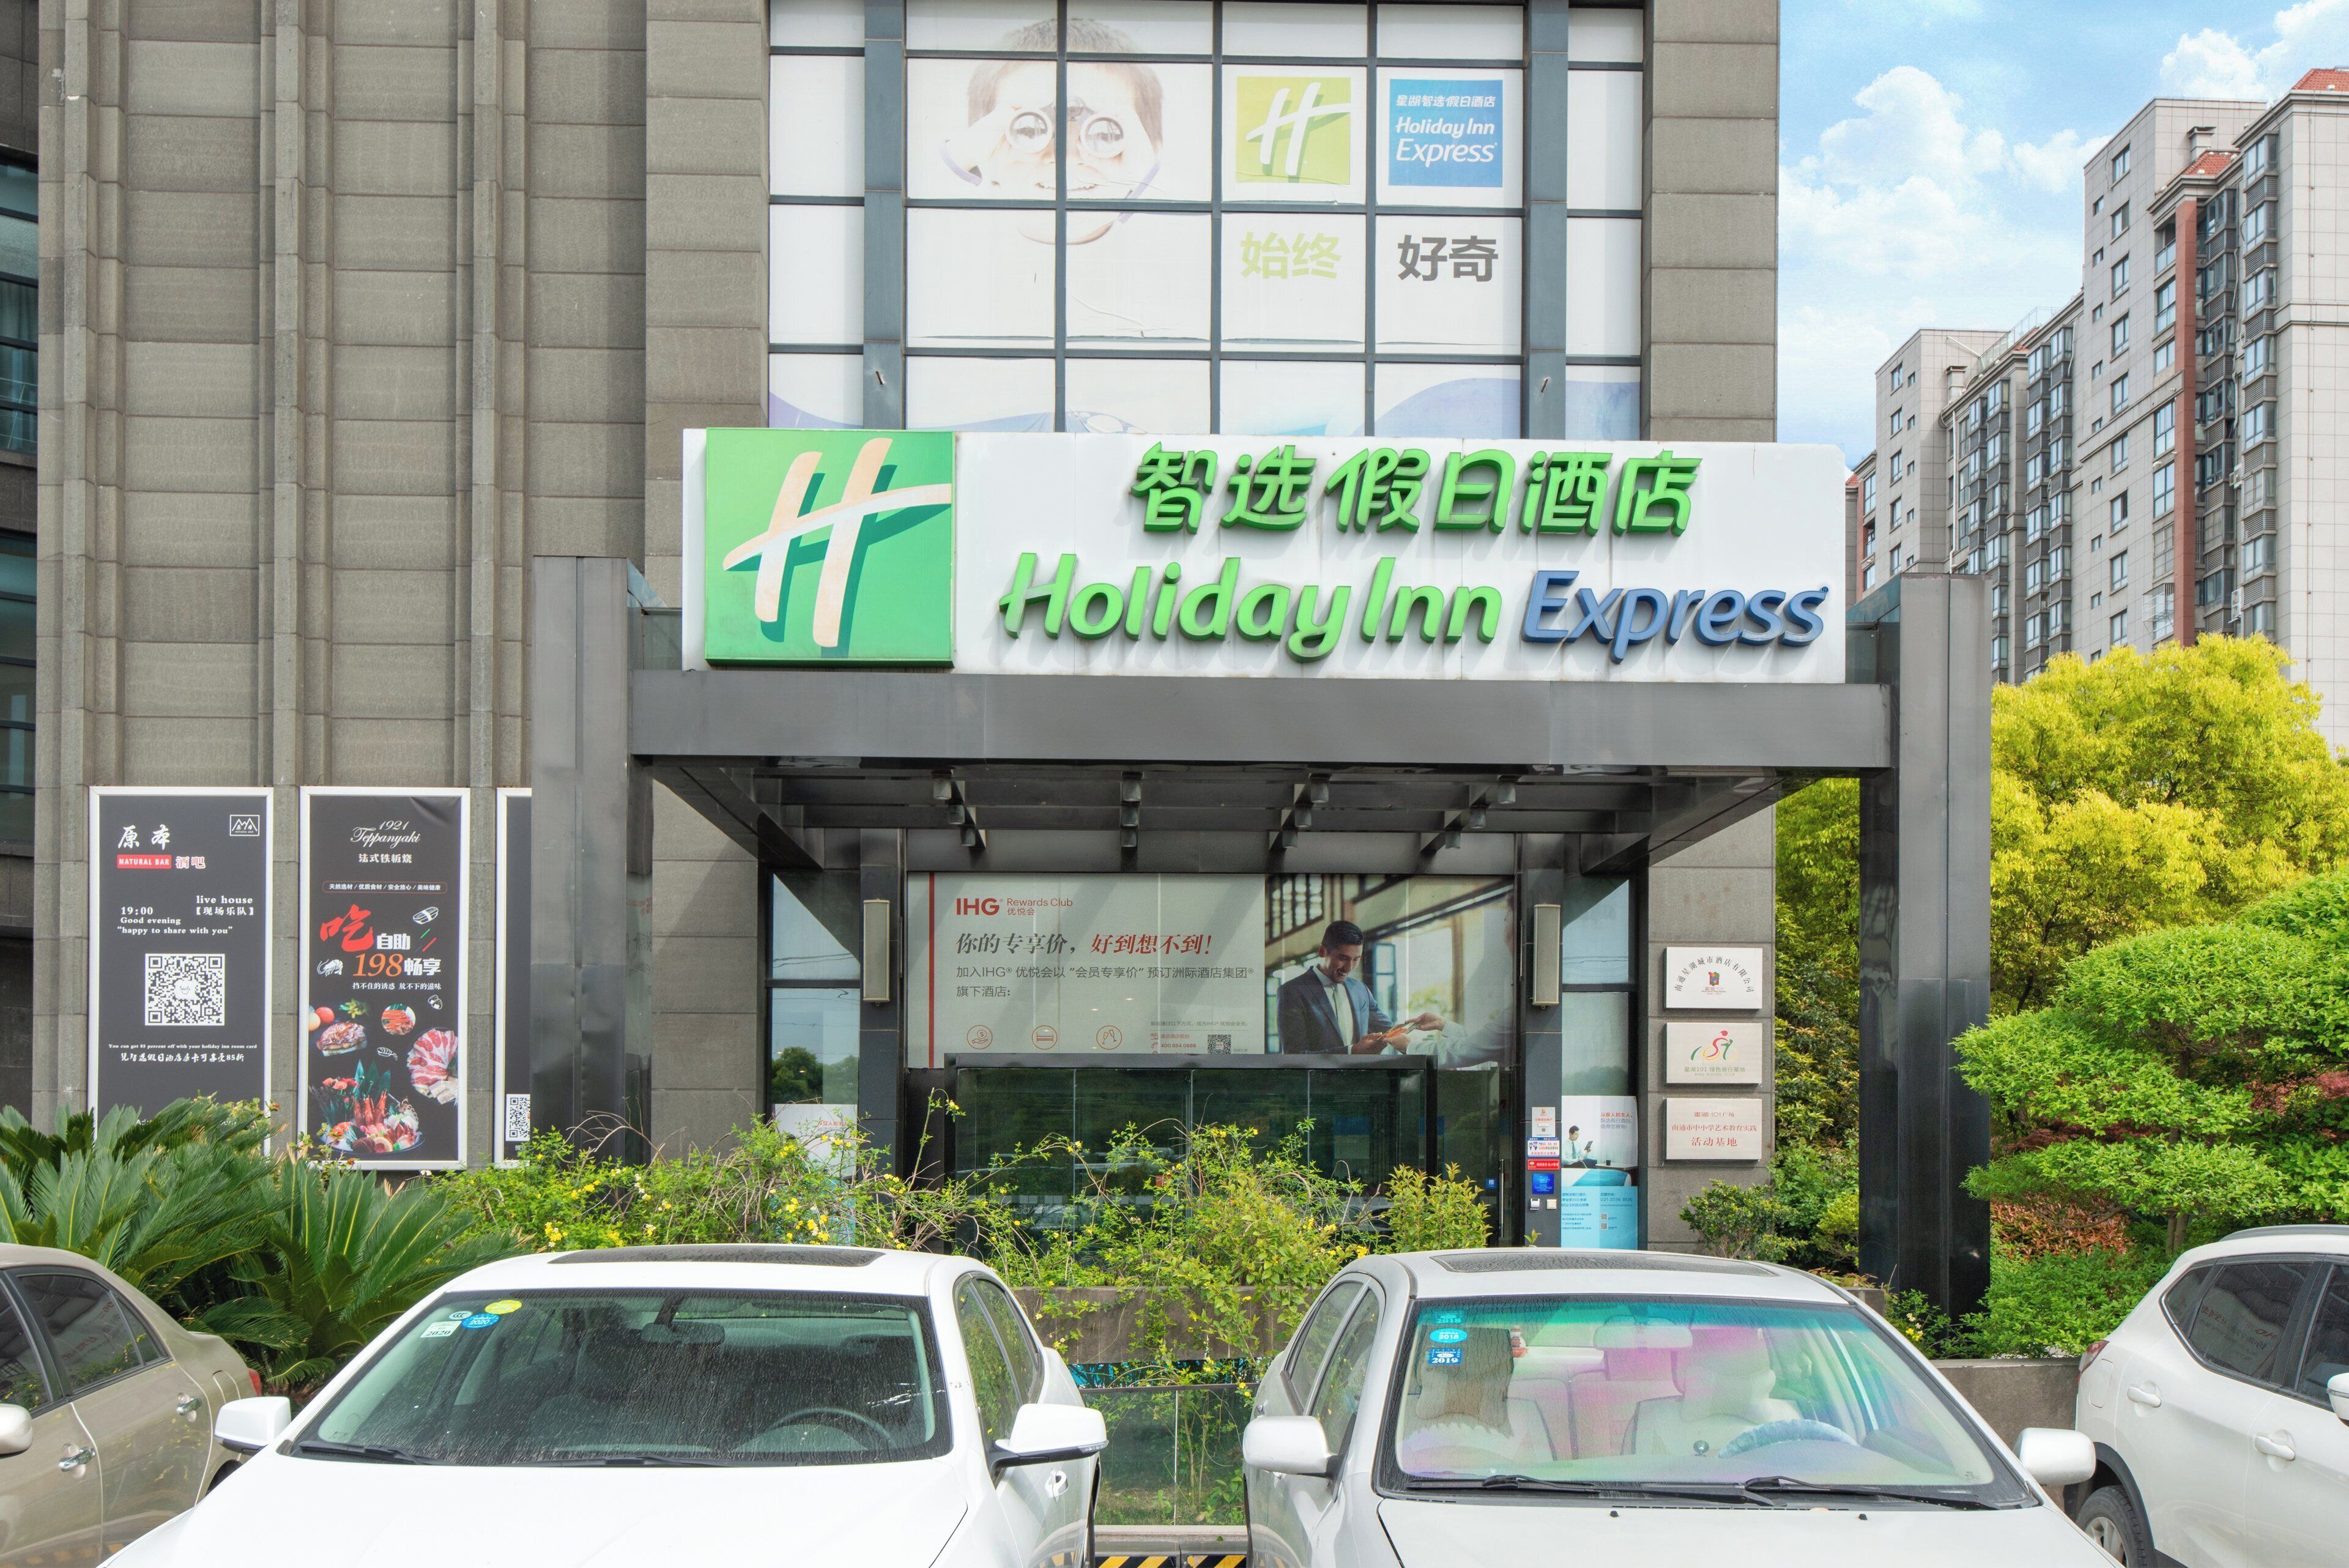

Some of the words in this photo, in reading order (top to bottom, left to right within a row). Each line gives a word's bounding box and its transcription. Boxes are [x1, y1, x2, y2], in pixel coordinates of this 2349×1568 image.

[1395, 94, 1496, 108] 星湖智选假日酒店
[1395, 116, 1466, 138] Holiday
[1466, 118, 1495, 135] Inn
[1240, 231, 1341, 280] 始终
[1397, 234, 1499, 283] 好奇
[1130, 441, 1703, 537] 智选假日酒店
[998, 552, 1352, 663] Holiday
[1360, 557, 1502, 644] Inn
[379, 820, 410, 831] 1921
[350, 826, 421, 849] Teppanyaki
[175, 856, 206, 869] 酒吧
[358, 853, 412, 863] 法式铁板烧
[196, 895, 217, 904] live
[221, 896, 253, 904] house
[1007, 898, 1048, 907] Rewards
[1050, 898, 1074, 907] Club
[121, 906, 154, 916] 19:00
[319, 904, 374, 953] 吃
[377, 933, 410, 950] 自助
[352, 953, 404, 978] 198
[404, 957, 442, 976] 畅享
[399, 983, 442, 991] 放不下的滋味
[1691, 1137, 1737, 1147] 活动基地
